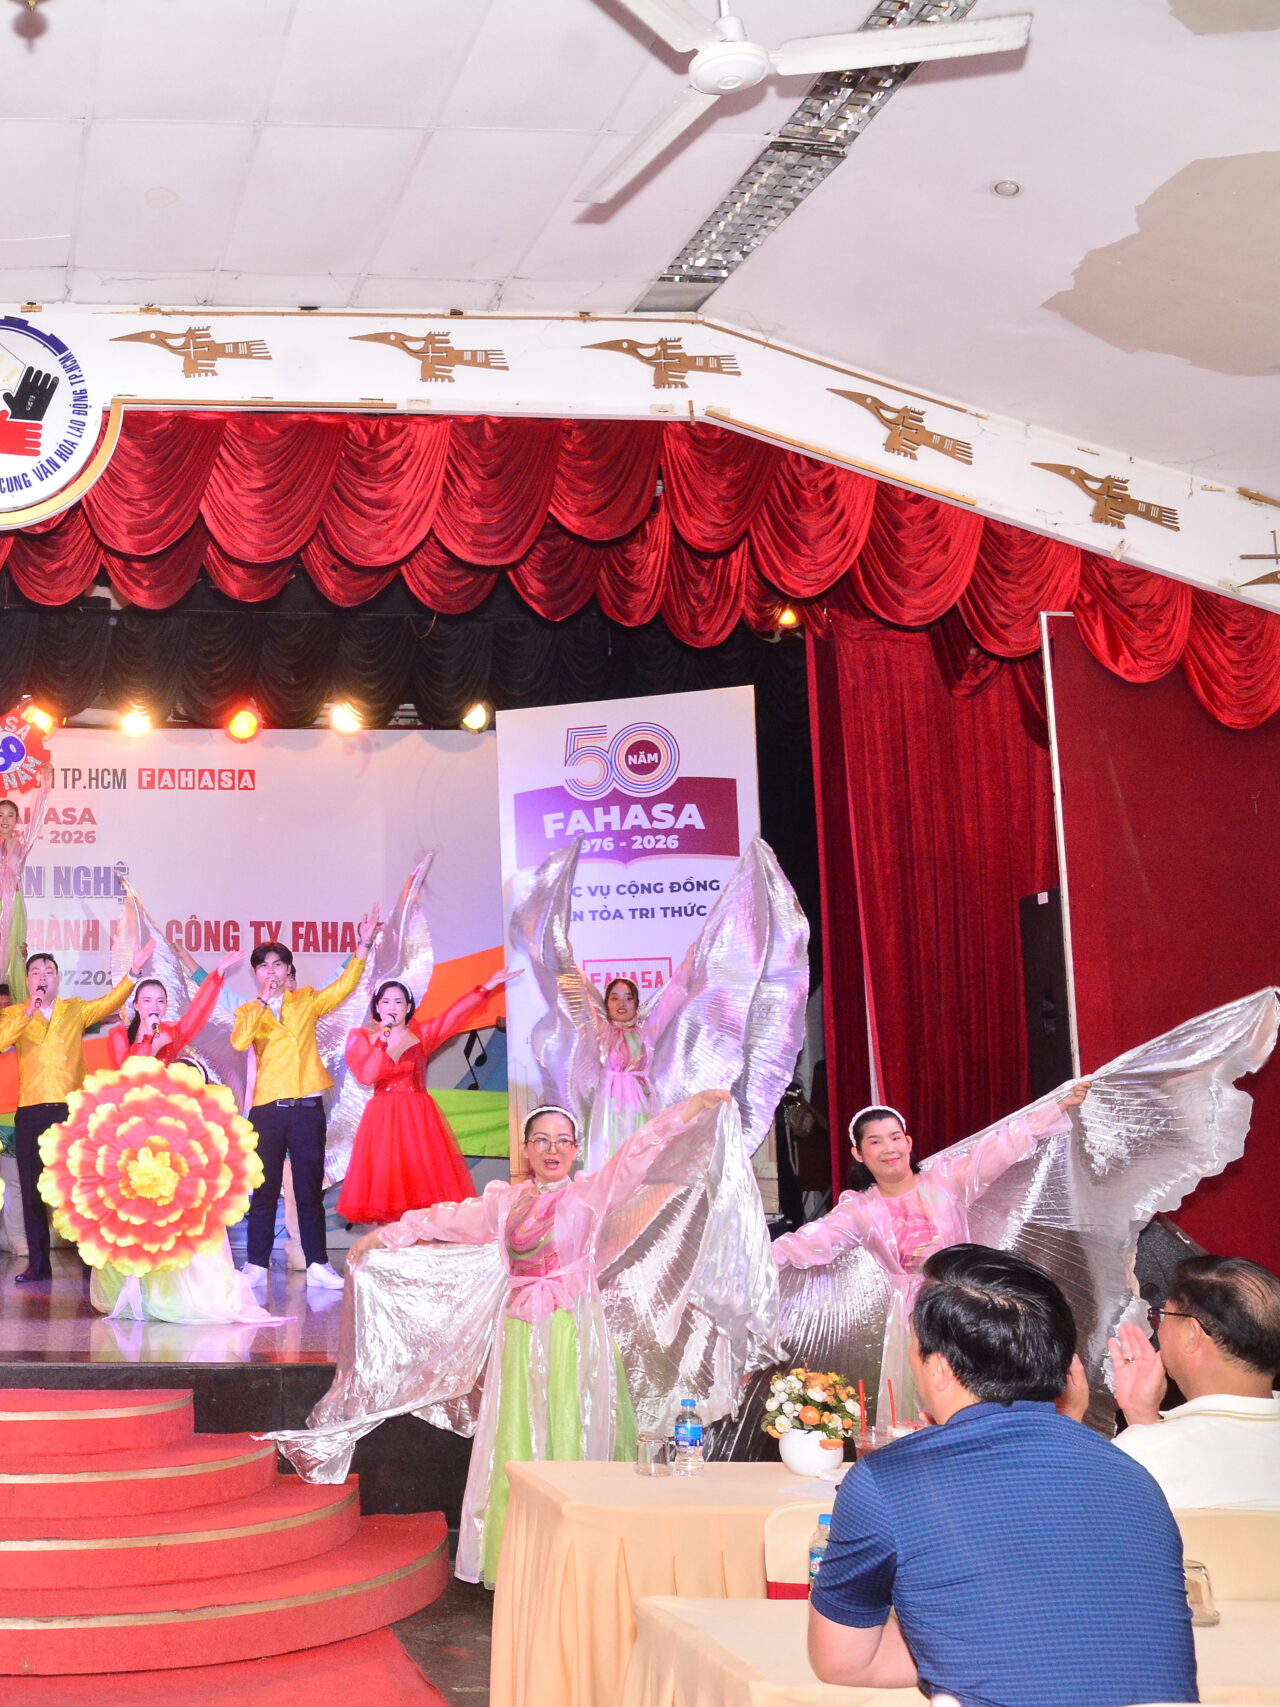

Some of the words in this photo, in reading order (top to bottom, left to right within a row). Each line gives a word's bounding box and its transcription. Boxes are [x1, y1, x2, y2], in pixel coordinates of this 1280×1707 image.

[58, 351, 86, 387] TP.HCM
[69, 388, 92, 417] ĐỘNG
[66, 419, 86, 439] LAO
[54, 439, 79, 462] HÓA
[32, 456, 61, 482] VĂN
[0, 472, 33, 494] CUNG
[564, 721, 680, 798] 50
[627, 751, 658, 766] NĂM
[60, 768, 127, 790] TP.HCM
[138, 769, 256, 791] FAHASA
[543, 803, 705, 839] FAHASA
[49, 829, 97, 844] 2026
[631, 835, 679, 850] 2026
[587, 885, 611, 899] VỤ
[615, 880, 664, 896] CỘNG
[669, 876, 720, 894] ĐỒNG
[629, 908, 655, 920] TRI
[660, 902, 708, 918] THỨC
[165, 914, 240, 952] CÔNG
